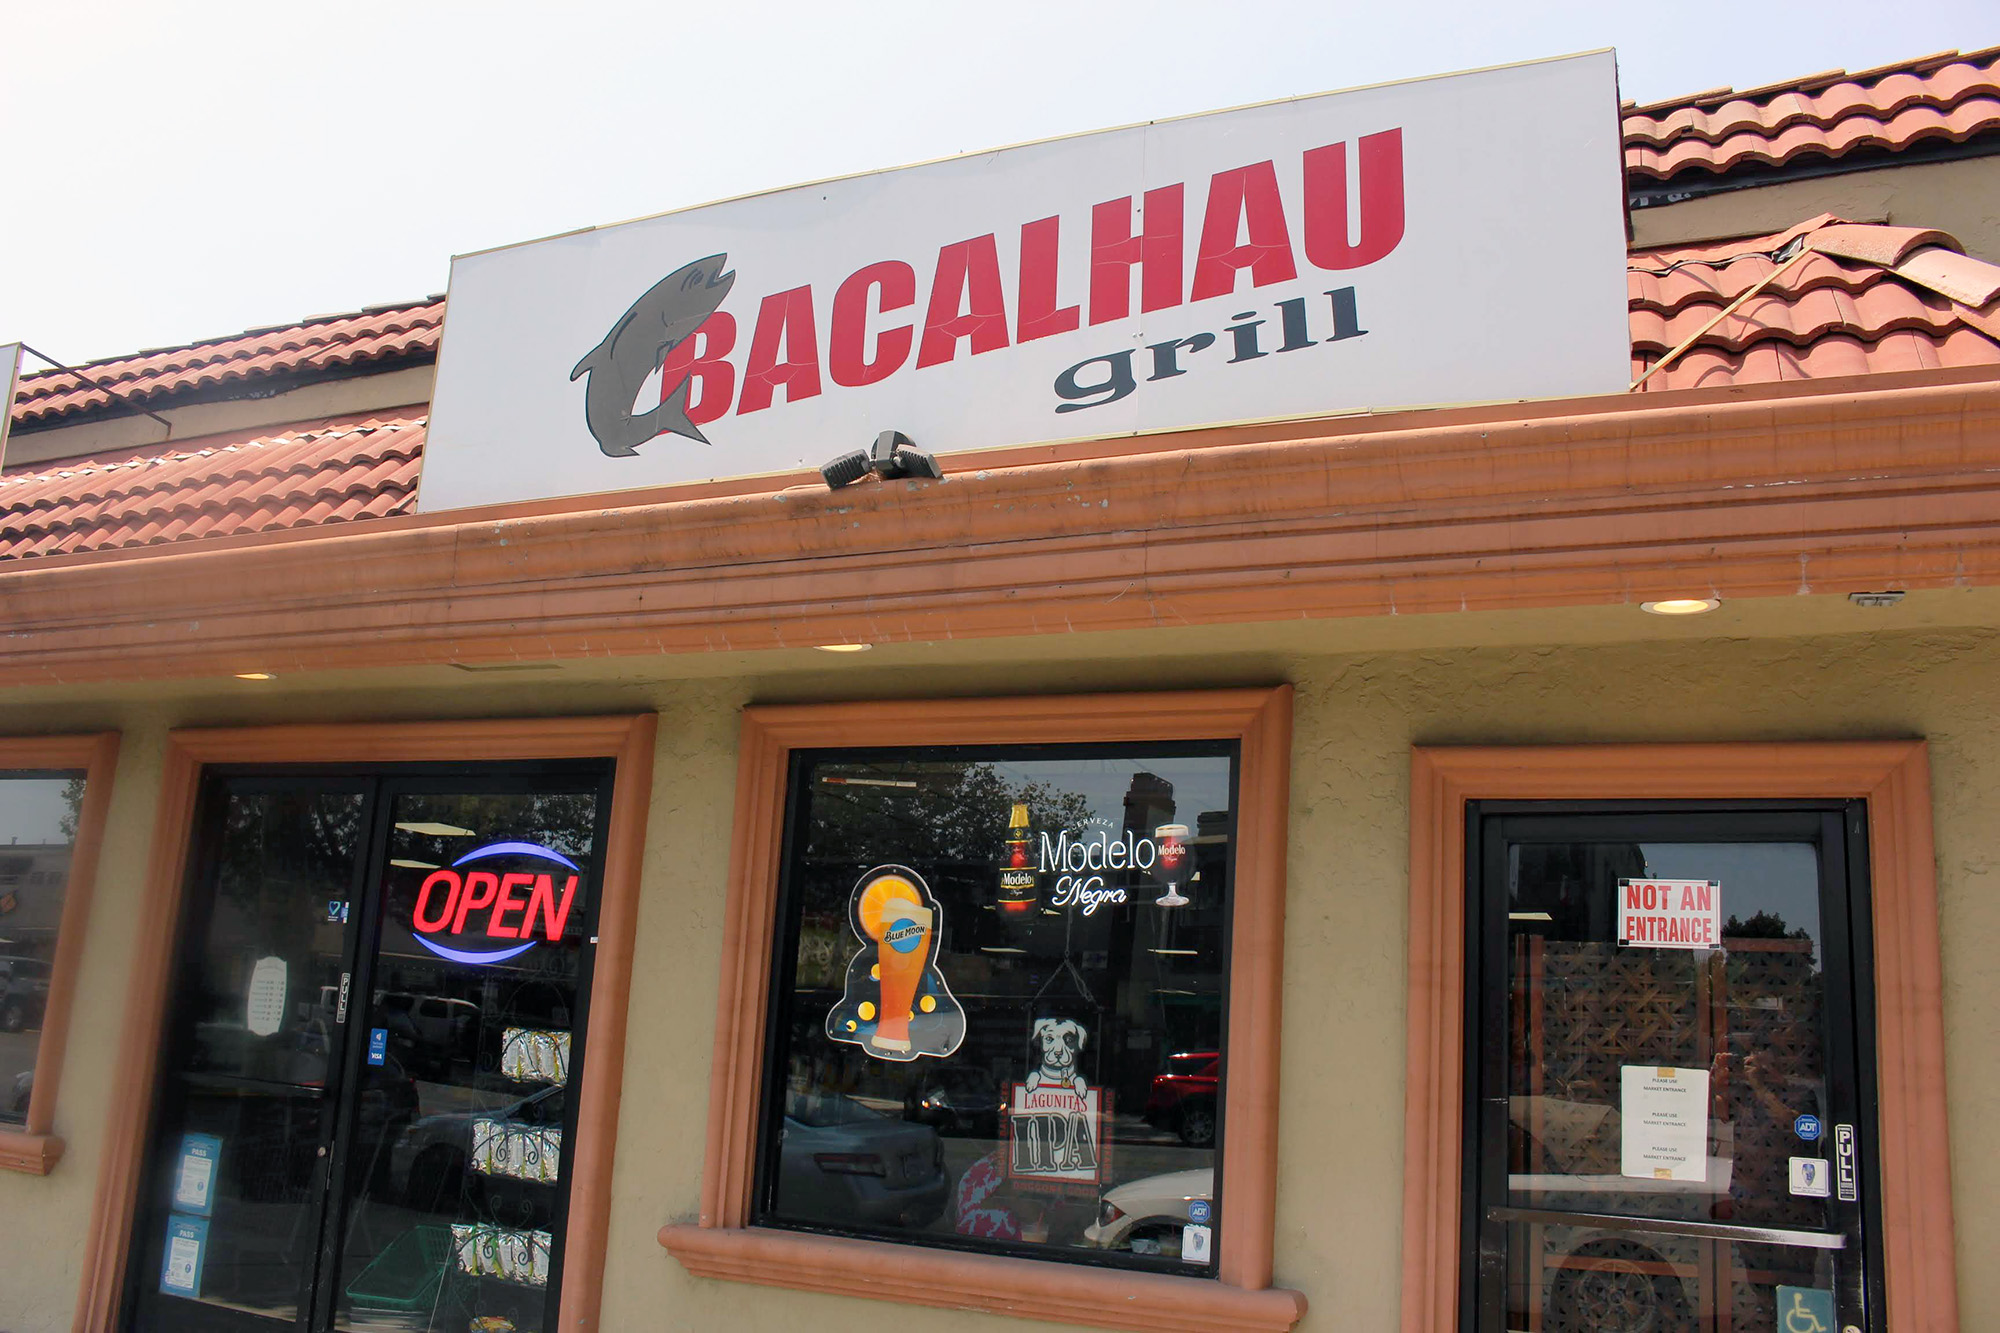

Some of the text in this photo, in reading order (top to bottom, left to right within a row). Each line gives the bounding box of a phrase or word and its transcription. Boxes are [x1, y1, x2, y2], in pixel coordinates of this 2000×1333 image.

[656, 126, 1406, 437] BACALHAU
[1053, 285, 1370, 414] grill
[1071, 817, 1115, 831] CERVEZA
[1038, 829, 1156, 873] Modelo
[1157, 844, 1186, 856] Modelo
[1003, 873, 1032, 886] Modelo
[412, 869, 580, 942] OPEN
[1051, 875, 1127, 917] Negra
[1626, 884, 1712, 911] NOT AN
[884, 926, 926, 943] BLUE MOON
[1626, 915, 1713, 943] ENTRANCE
[339, 977, 349, 1011] PULL
[1023, 1092, 1088, 1112] LAGUNITAS
[1799, 1122, 1817, 1132] ADT
[191, 1148, 207, 1158] PASS
[1010, 1111, 1098, 1173] IPA
[1838, 1130, 1853, 1182] PULL
[1192, 1207, 1207, 1217] ADT
[179, 1230, 195, 1239] PASS
